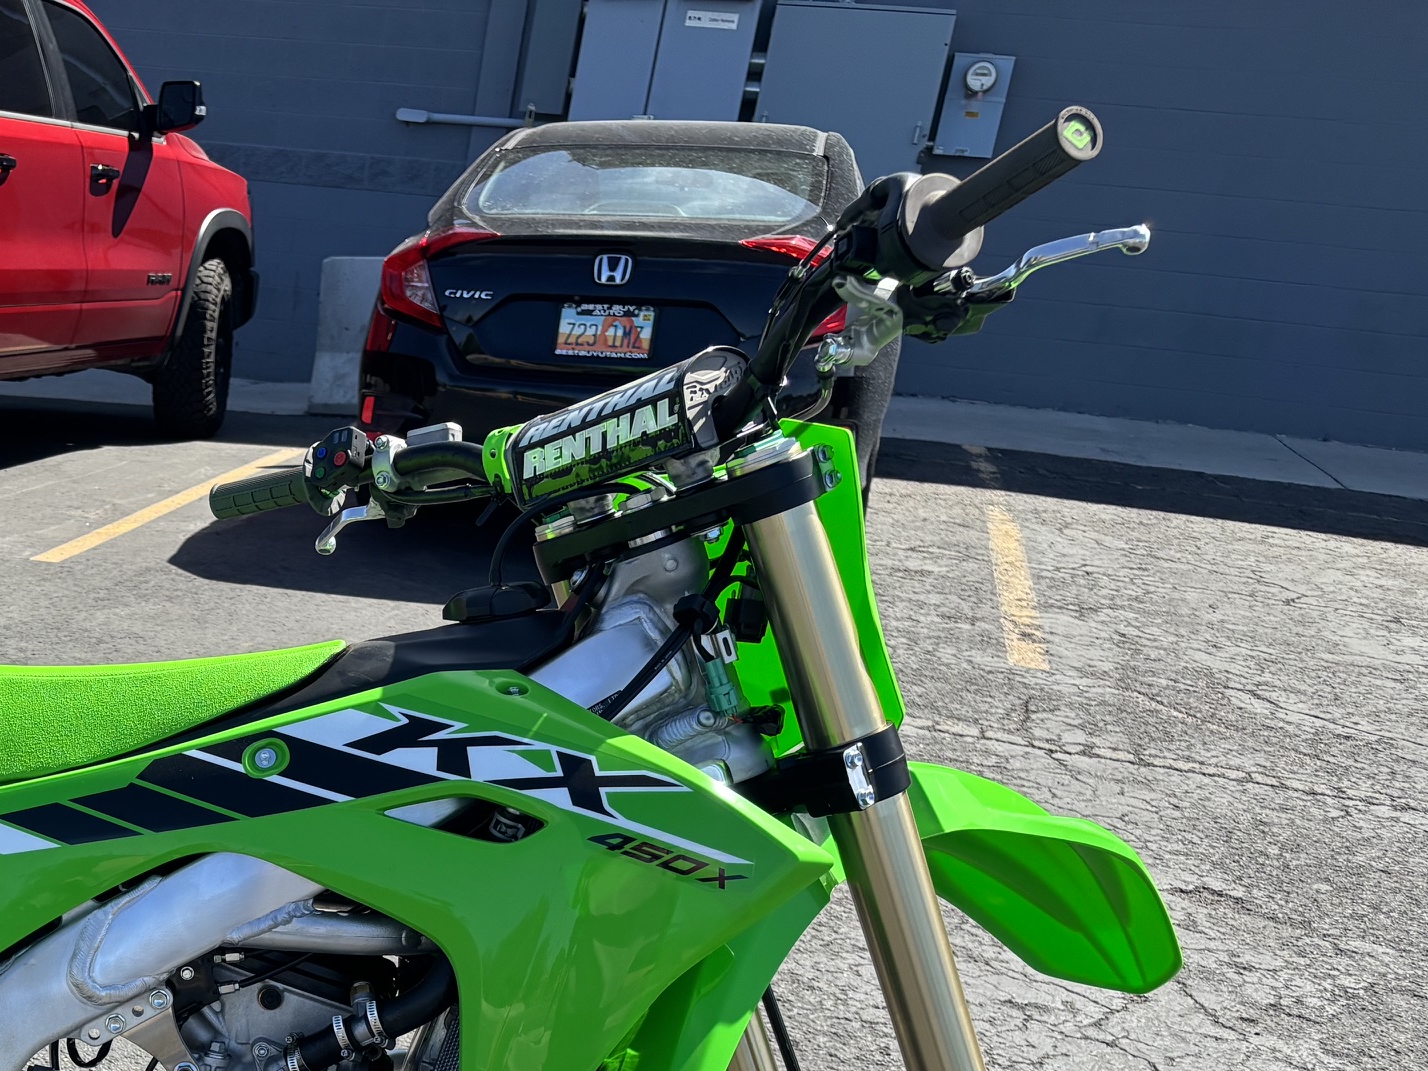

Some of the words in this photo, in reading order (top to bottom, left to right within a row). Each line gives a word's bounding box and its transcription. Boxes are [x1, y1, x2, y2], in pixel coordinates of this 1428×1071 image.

[444, 288, 494, 300] CIVIC
[580, 303, 610, 311] BEST
[611, 304, 637, 313] BUY
[591, 309, 625, 317] AUTO
[564, 321, 599, 347] Z23
[518, 367, 678, 448] RENTHAL
[522, 398, 679, 480] RENTHAL
[341, 709, 690, 821] KX
